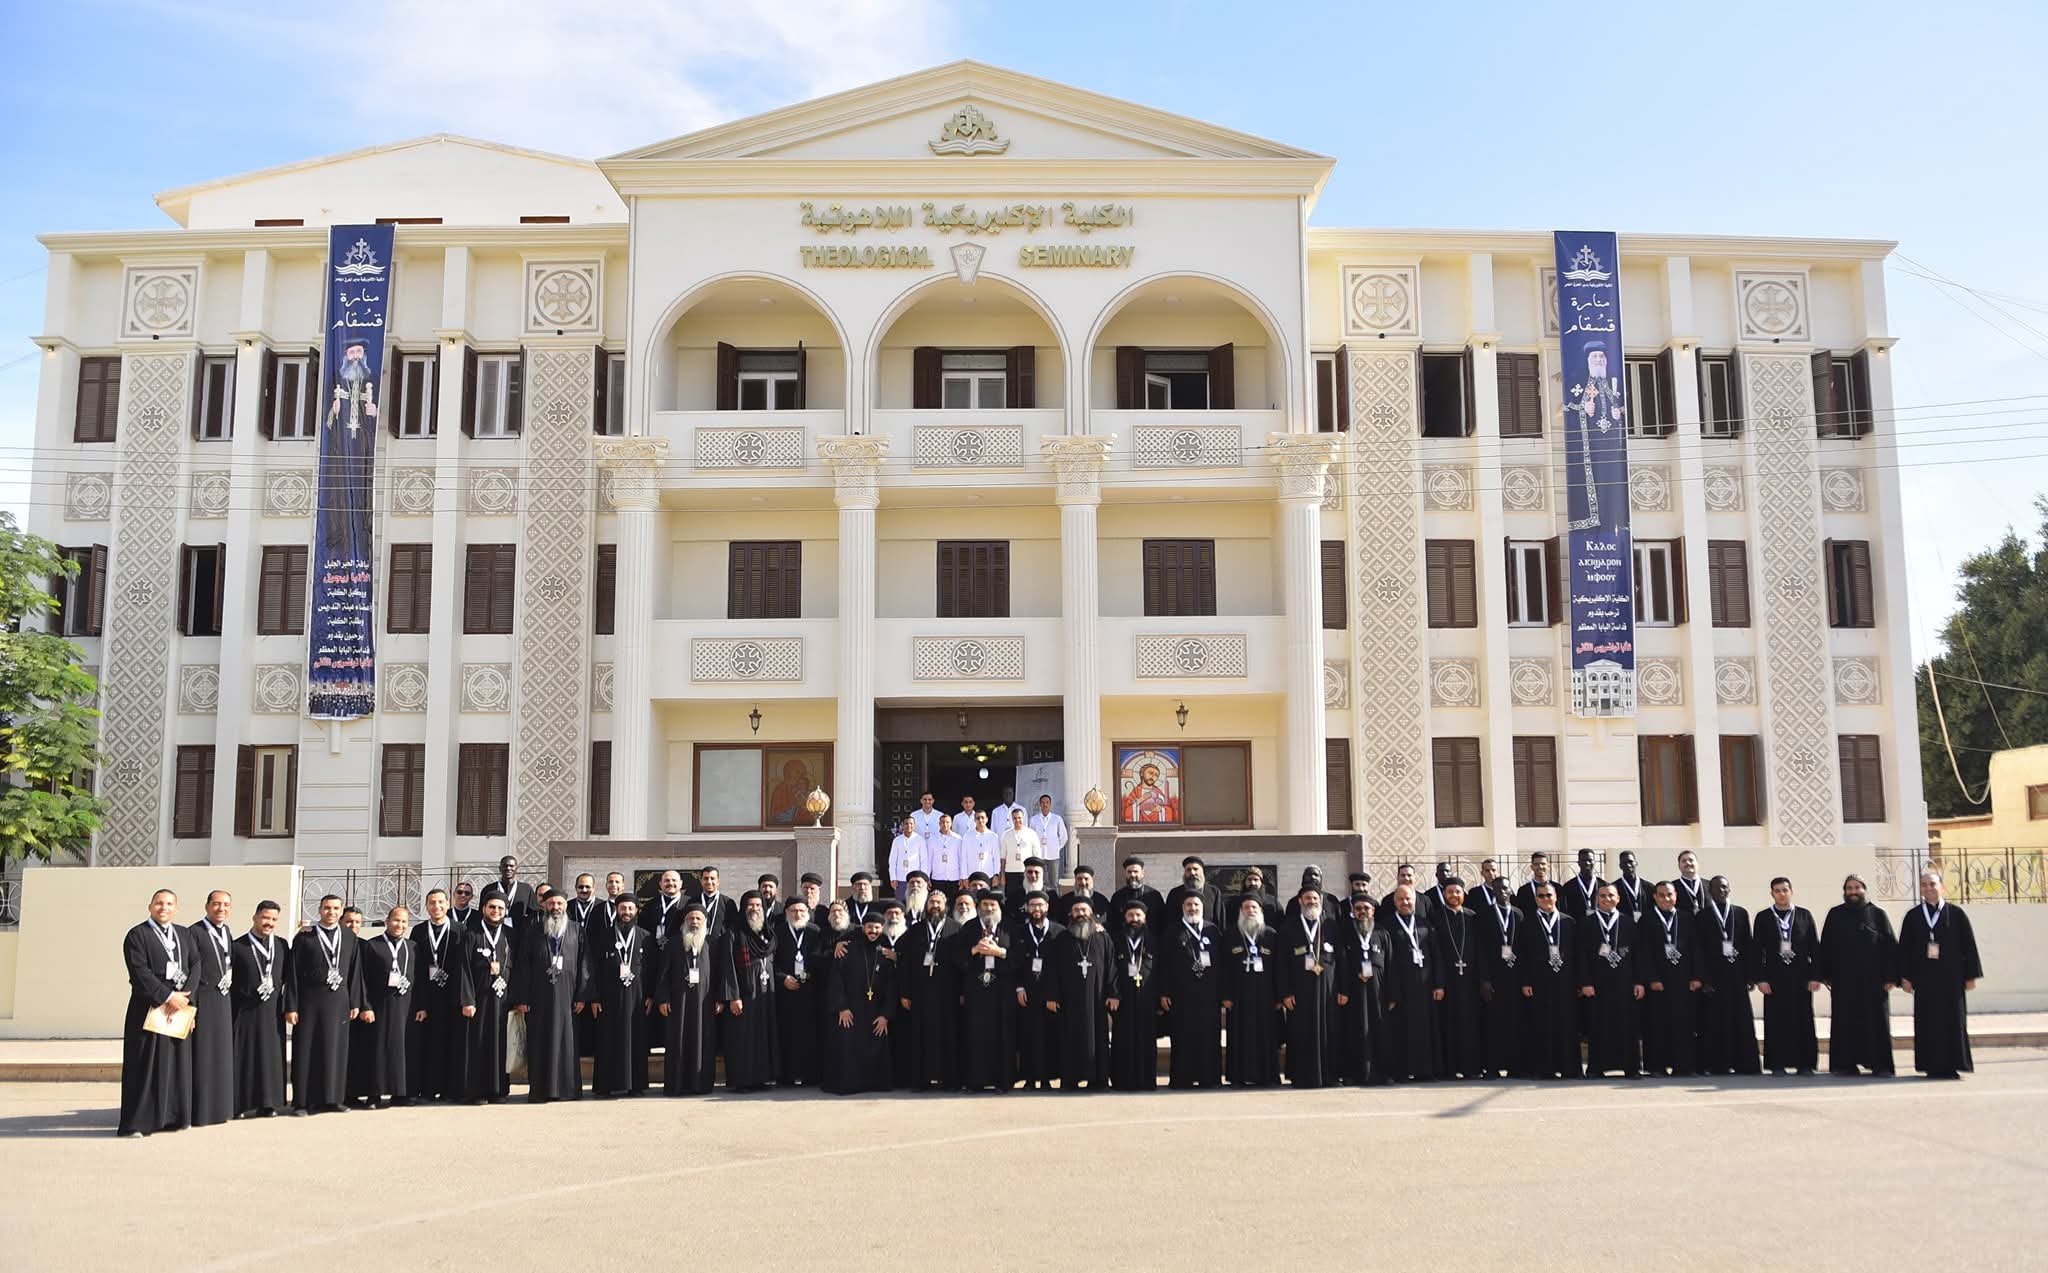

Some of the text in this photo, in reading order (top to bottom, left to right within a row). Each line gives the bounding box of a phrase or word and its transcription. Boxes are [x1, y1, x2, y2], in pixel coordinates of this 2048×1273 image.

[1062, 202, 1134, 234] الكلية
[800, 245, 1135, 268] THEOLOGICAL SEMINARY
[340, 287, 380, 307] منارة
[1570, 293, 1610, 311] منارة
